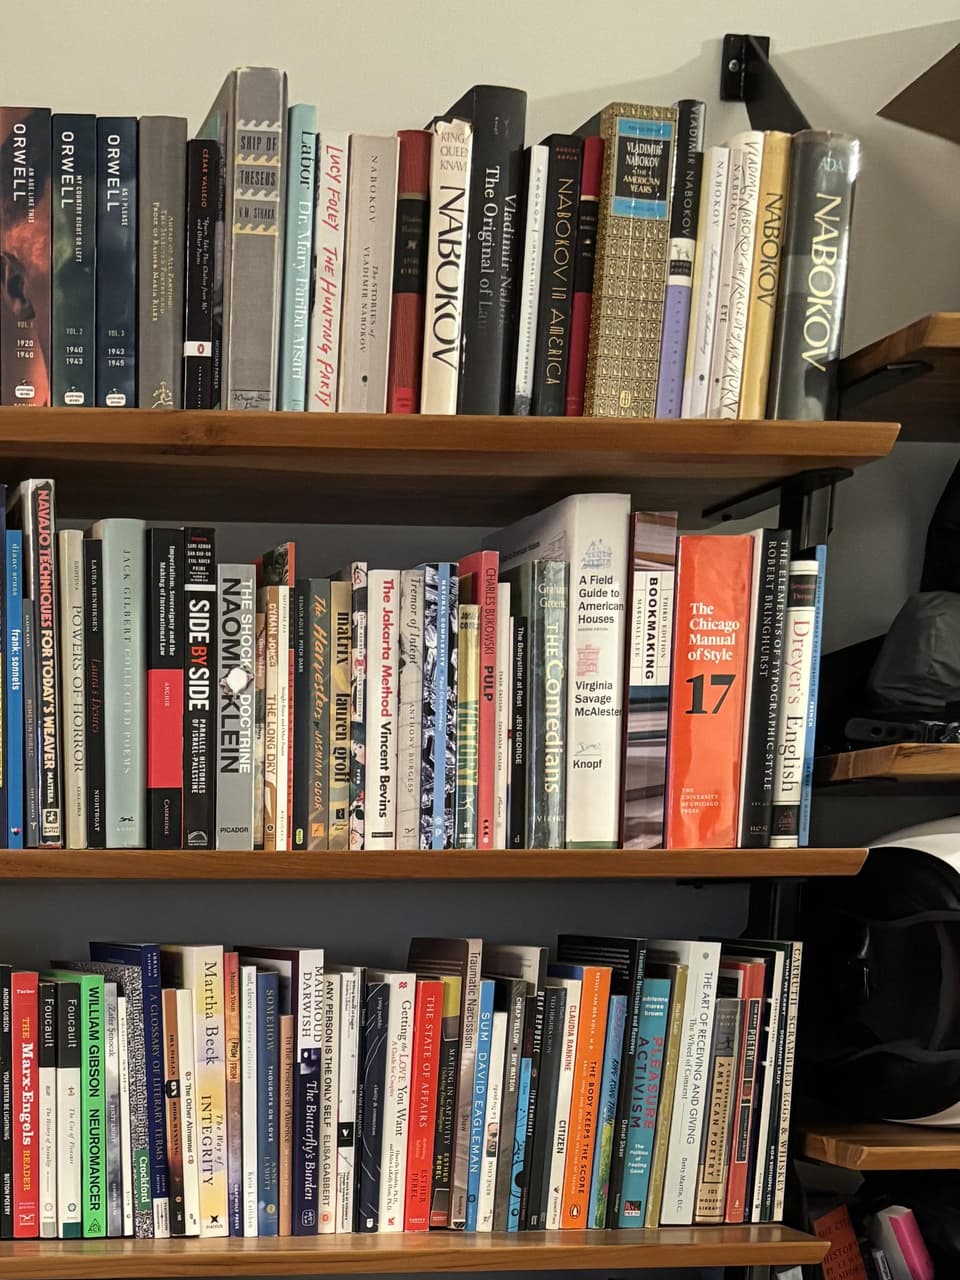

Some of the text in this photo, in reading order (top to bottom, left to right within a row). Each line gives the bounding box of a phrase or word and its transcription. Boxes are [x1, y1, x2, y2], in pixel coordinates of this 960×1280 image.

[13, 124, 26, 201] ORWELL
[61, 131, 74, 208] ORWELL
[107, 135, 120, 212] ORWELL
[315, 145, 344, 407] LUCY FOLEY THE HUNTING PARTY
[757, 192, 783, 309] NABOKOV
[801, 192, 842, 372] NABOKOV
[579, 602, 623, 611] American
[580, 576, 612, 584] A Field
[580, 588, 619, 598] Guide to
[690, 603, 714, 614] The
[188, 599, 209, 711] SIDE BY SIDE
[578, 615, 614, 623] Houses
[645, 577, 658, 680] BOOKMAKING
[688, 635, 736, 646] Manual
[688, 651, 733, 662] of Style
[689, 619, 739, 631] Chicago
[239, 579, 253, 773] THE SHOCK DOCTRINE
[378, 579, 394, 818] The Jakarta Method Vincent Bevins
[484, 665, 493, 701] PULP
[575, 695, 612, 704] Savage
[576, 681, 613, 691] Virginia
[685, 674, 737, 715] 17
[779, 620, 810, 793] Dreyer's English
[221, 695, 240, 774] KLEIN
[573, 759, 602, 769] Knopf
[44, 998, 55, 1048] Foucault
[67, 999, 77, 1048] Foucault
[204, 962, 220, 1066] Martha Beck
[20, 1017, 35, 1191] THE Marx-Engels READER
[88, 987, 101, 1211] WILLIAM GIBSON NEUROMANCER
[469, 1012, 490, 1174] SUM DAVID EAGLEMAN
[140, 1156, 150, 1202] Crockford
[201, 1095, 213, 1186] INTEGRITY
[304, 1081, 317, 1200] The Butterfly's Burden
